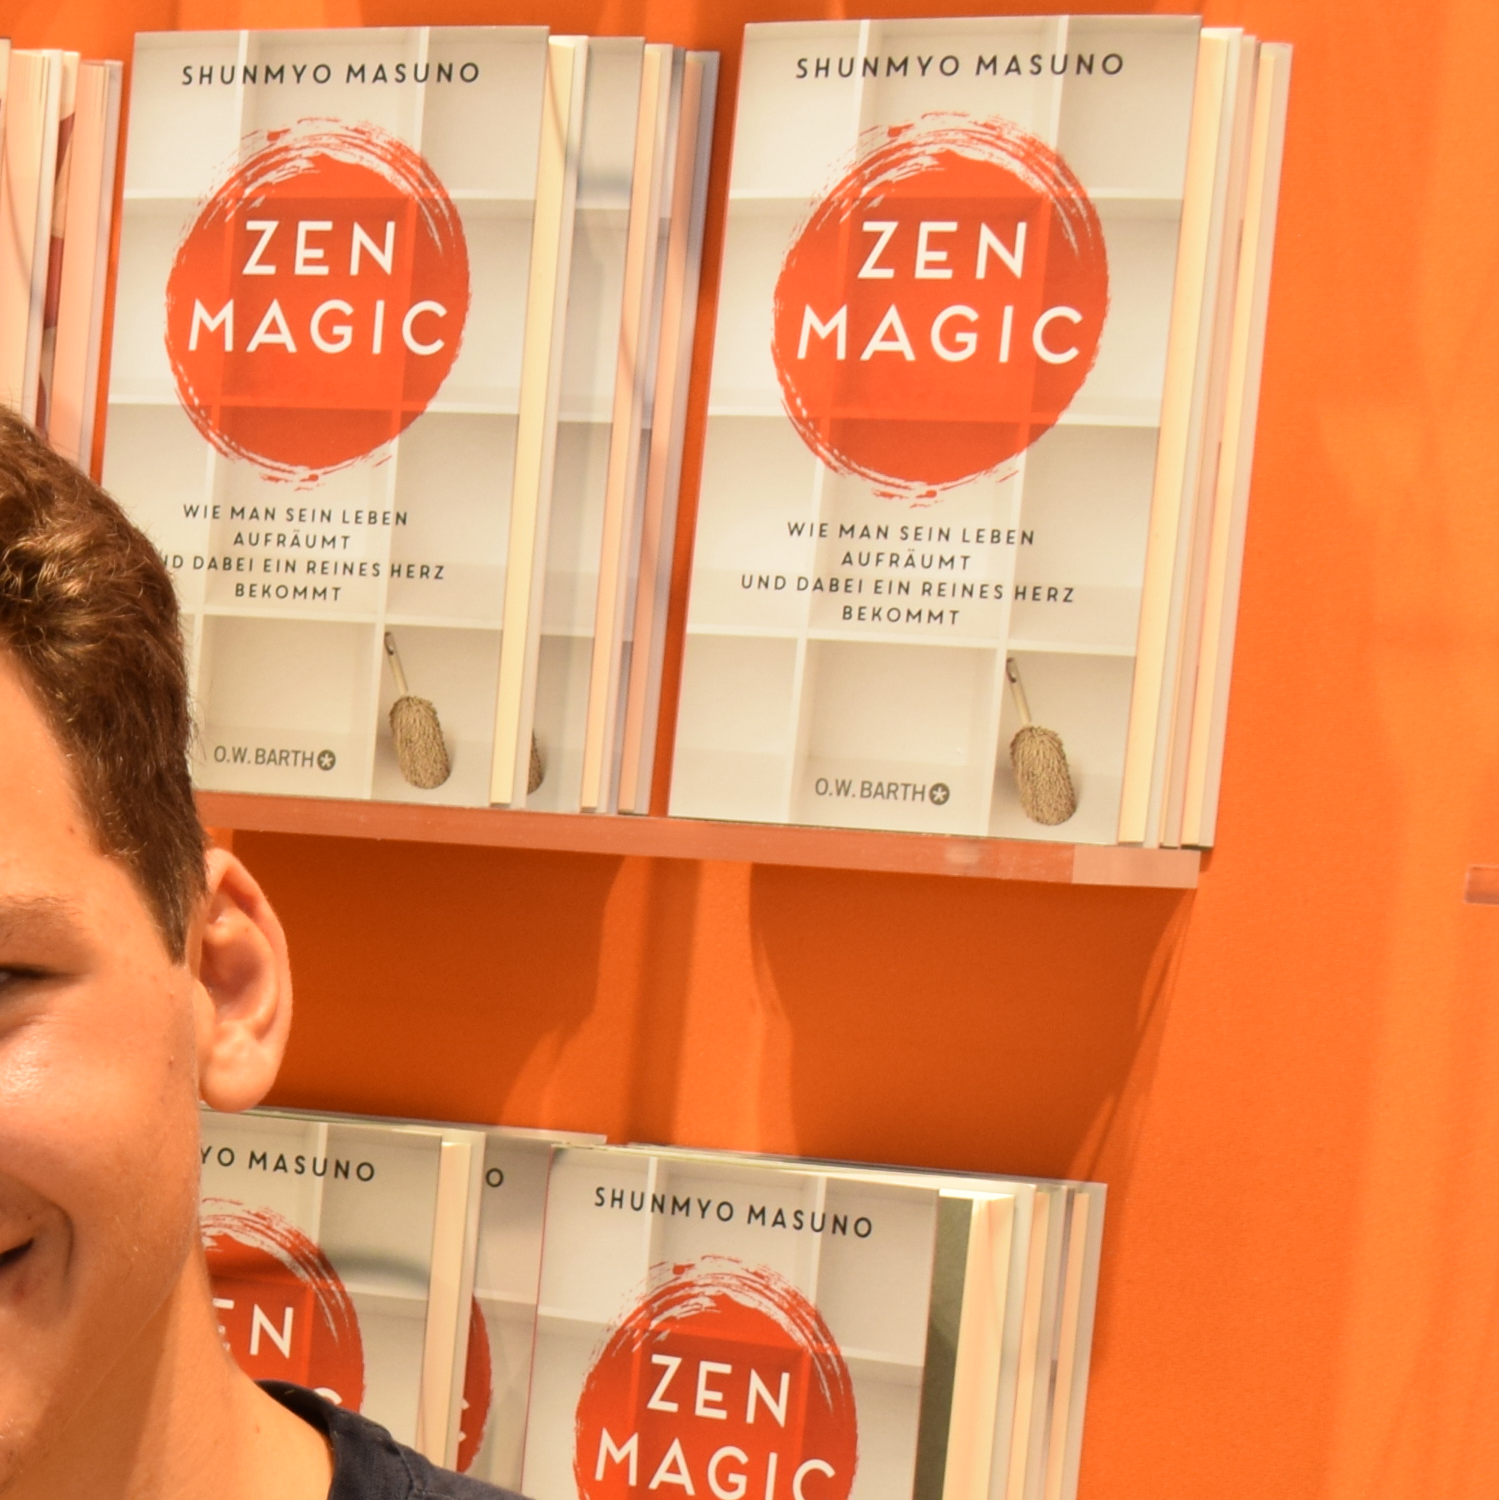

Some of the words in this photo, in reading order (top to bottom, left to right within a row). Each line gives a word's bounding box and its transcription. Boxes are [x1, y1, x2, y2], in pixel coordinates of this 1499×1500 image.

[181, 64, 332, 86] SHUNMYO
[346, 62, 480, 84] MASUNO
[795, 55, 961, 79] SHUNMYO
[975, 53, 1125, 77] MASUNO
[242, 220, 396, 276] ZEN
[857, 220, 1028, 280] ZEN
[188, 299, 448, 356] MAGIC
[797, 303, 1083, 364] MAGIC
[183, 503, 221, 520] WIE
[230, 505, 276, 522] MAN
[285, 507, 332, 524] SEIN
[341, 508, 409, 526] LEBEN
[233, 528, 351, 550] AUFRÄUMT
[787, 522, 829, 539] WIE
[839, 524, 891, 541] MAN
[900, 525, 952, 543] SEIN
[962, 528, 1035, 546] LEBEN
[193, 555, 254, 573] DABEI
[263, 558, 297, 574] EIN
[306, 559, 382, 578] REINES
[390, 563, 445, 581] HERZ
[841, 547, 972, 571] AUFRÄUMT
[234, 583, 342, 602] BEKOMMT
[741, 574, 788, 591] UND
[797, 576, 863, 594] DABEI
[873, 579, 911, 597] EIN
[922, 581, 1004, 601] REINES
[1014, 585, 1075, 604] HERZ
[842, 606, 961, 626] BEKOMMT
[213, 745, 252, 766] O.W.
[255, 748, 314, 769] BARTH
[814, 778, 856, 798] O.W.
[859, 780, 926, 803] BARTH
[248, 1150, 375, 1182] MASUNO
[595, 1187, 735, 1223] SHUNMYO
[747, 1204, 874, 1239] MASUNO
[648, 1353, 791, 1429] ZEN
